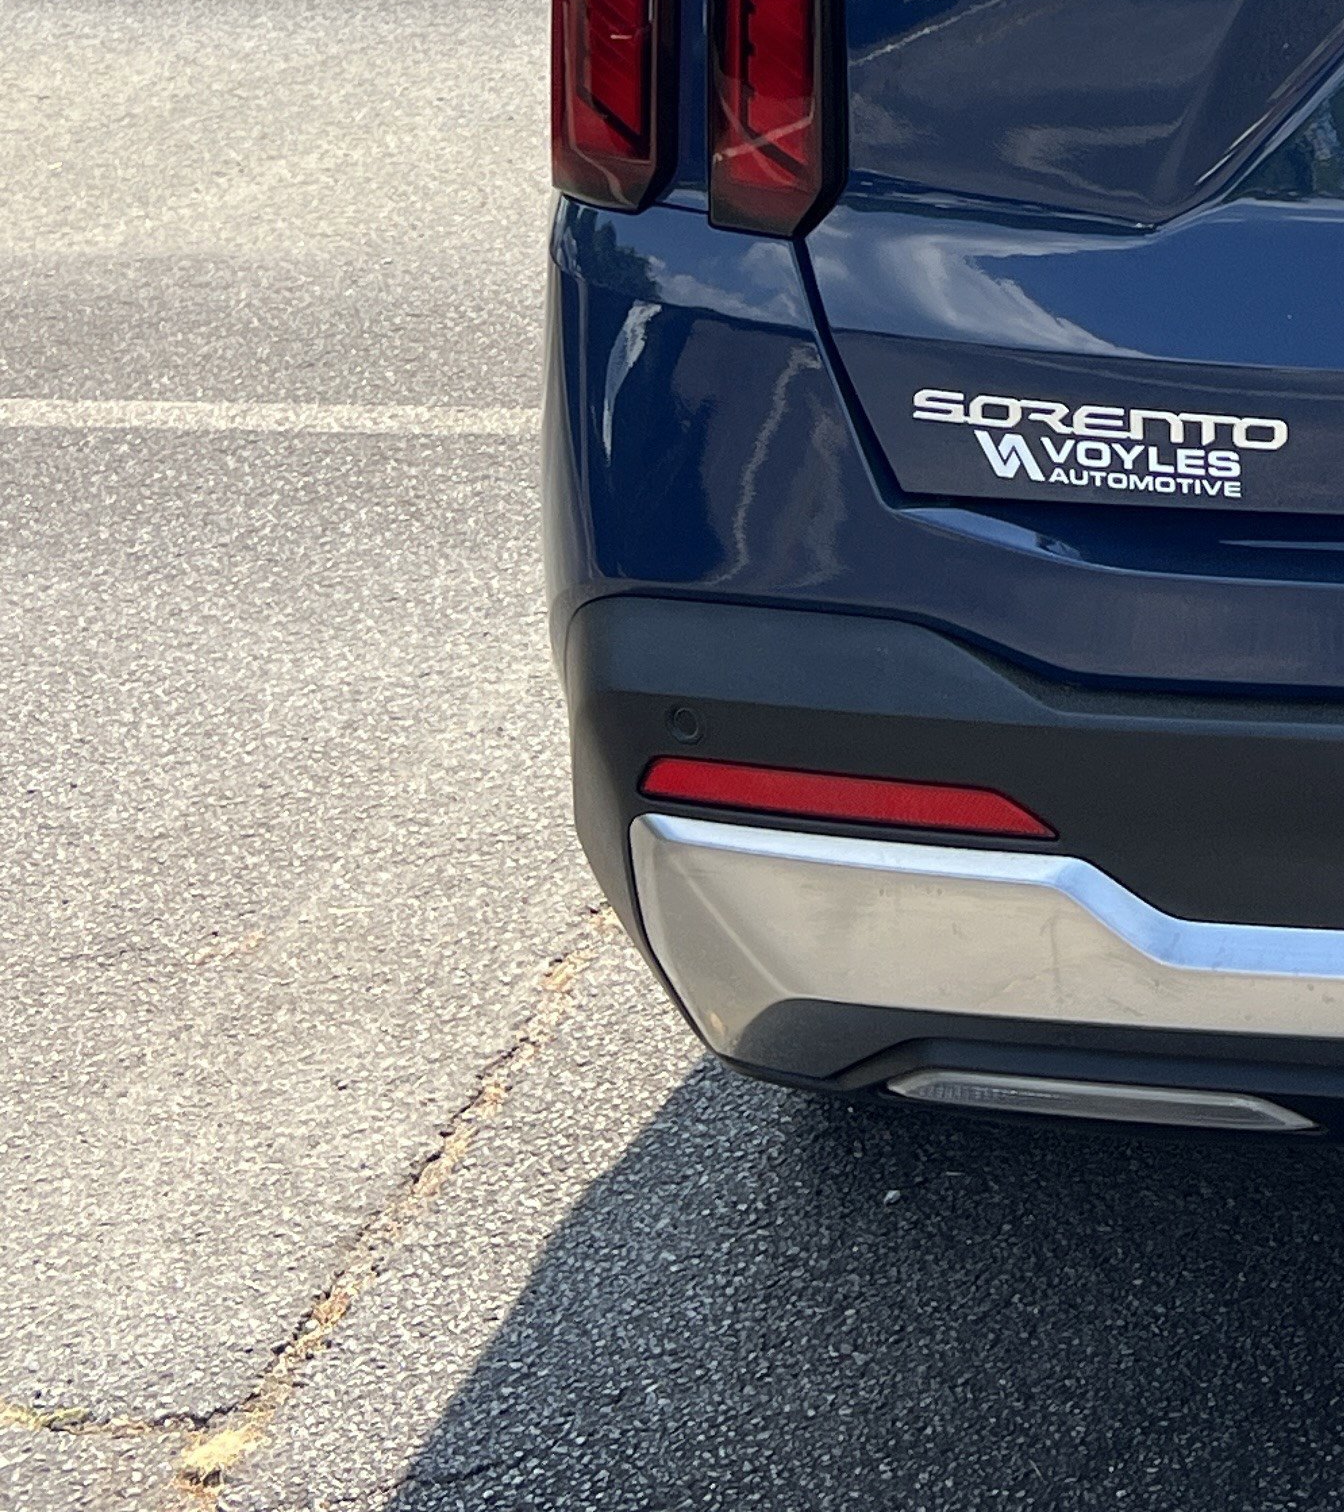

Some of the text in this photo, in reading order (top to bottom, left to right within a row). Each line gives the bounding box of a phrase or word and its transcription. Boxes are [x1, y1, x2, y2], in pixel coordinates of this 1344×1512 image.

[912, 388, 1289, 451] SORENTO
[1040, 436, 1242, 478] VOYLES
[1048, 467, 1242, 498] AUTOMOTIVE
